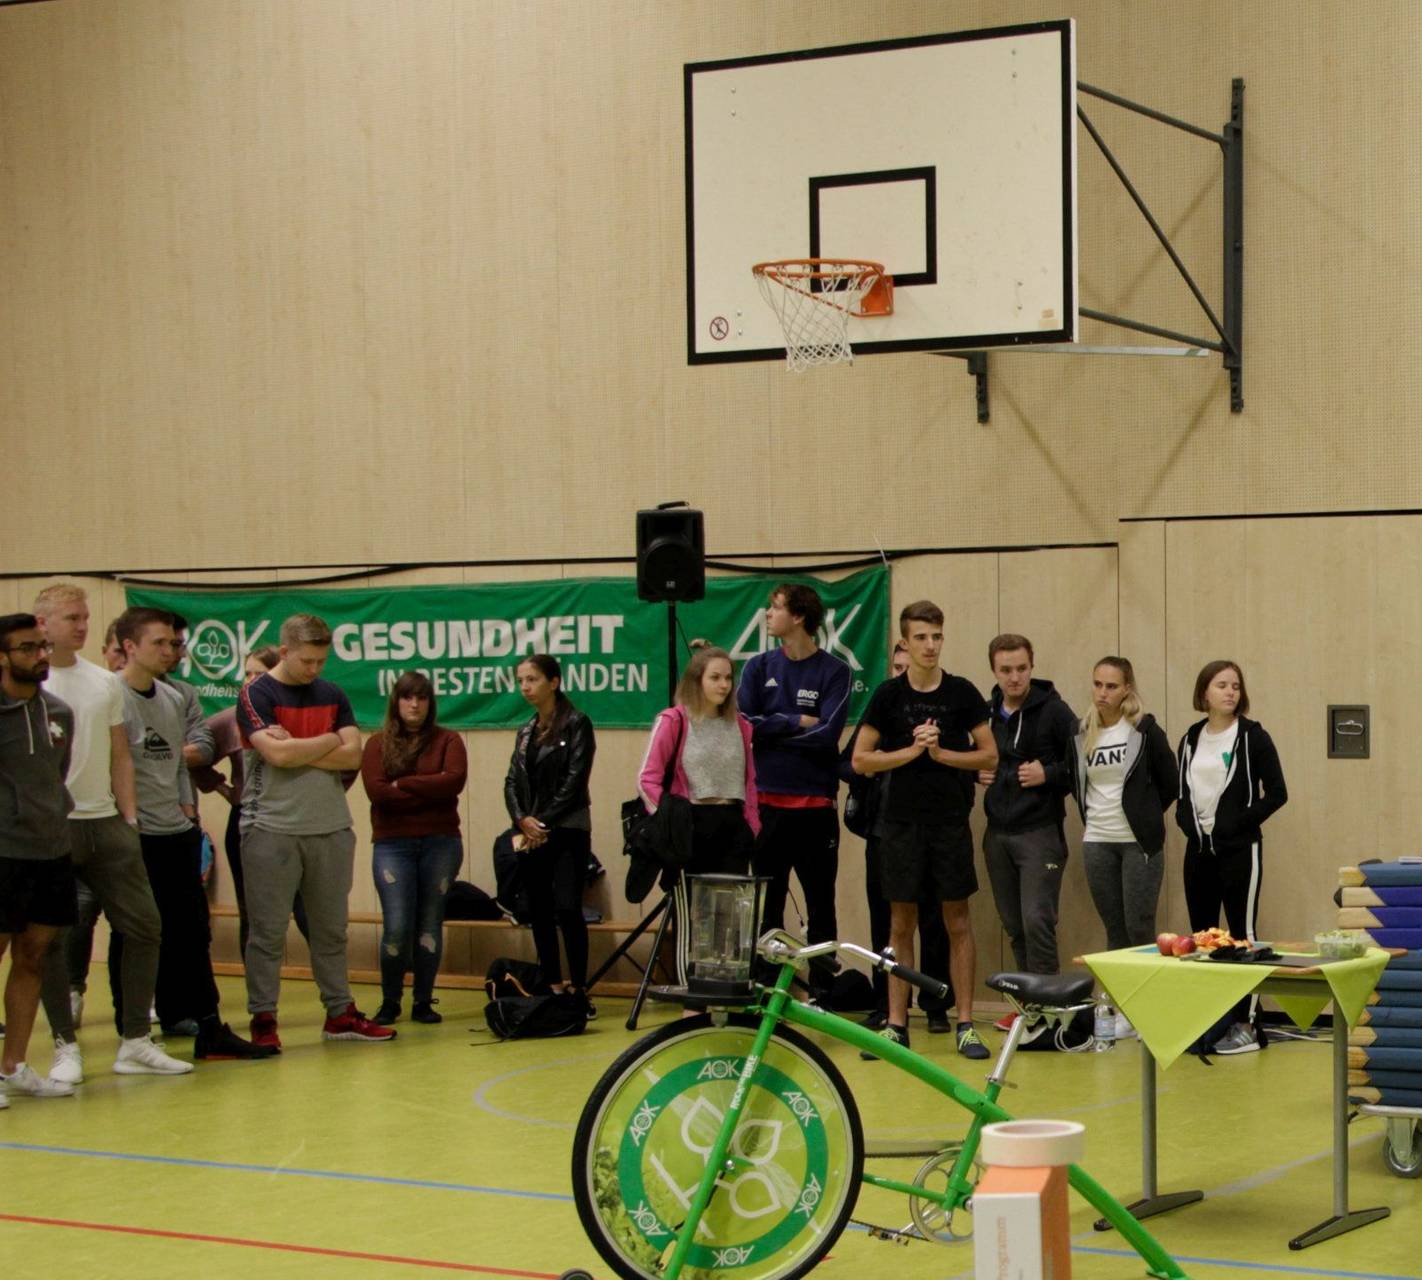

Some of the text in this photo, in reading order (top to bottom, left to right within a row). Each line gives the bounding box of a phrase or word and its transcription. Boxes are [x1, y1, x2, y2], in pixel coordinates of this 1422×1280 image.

[332, 614, 625, 661] GESUNDHEIT
[730, 603, 864, 671] AK
[557, 658, 649, 693] NDEN
[697, 1058, 741, 1081] AOK
[629, 1099, 662, 1147] AOK
[782, 1091, 818, 1127] AOK
[795, 1173, 822, 1219] AOK
[629, 1200, 669, 1237] AOK
[712, 1245, 755, 1268] AOK
